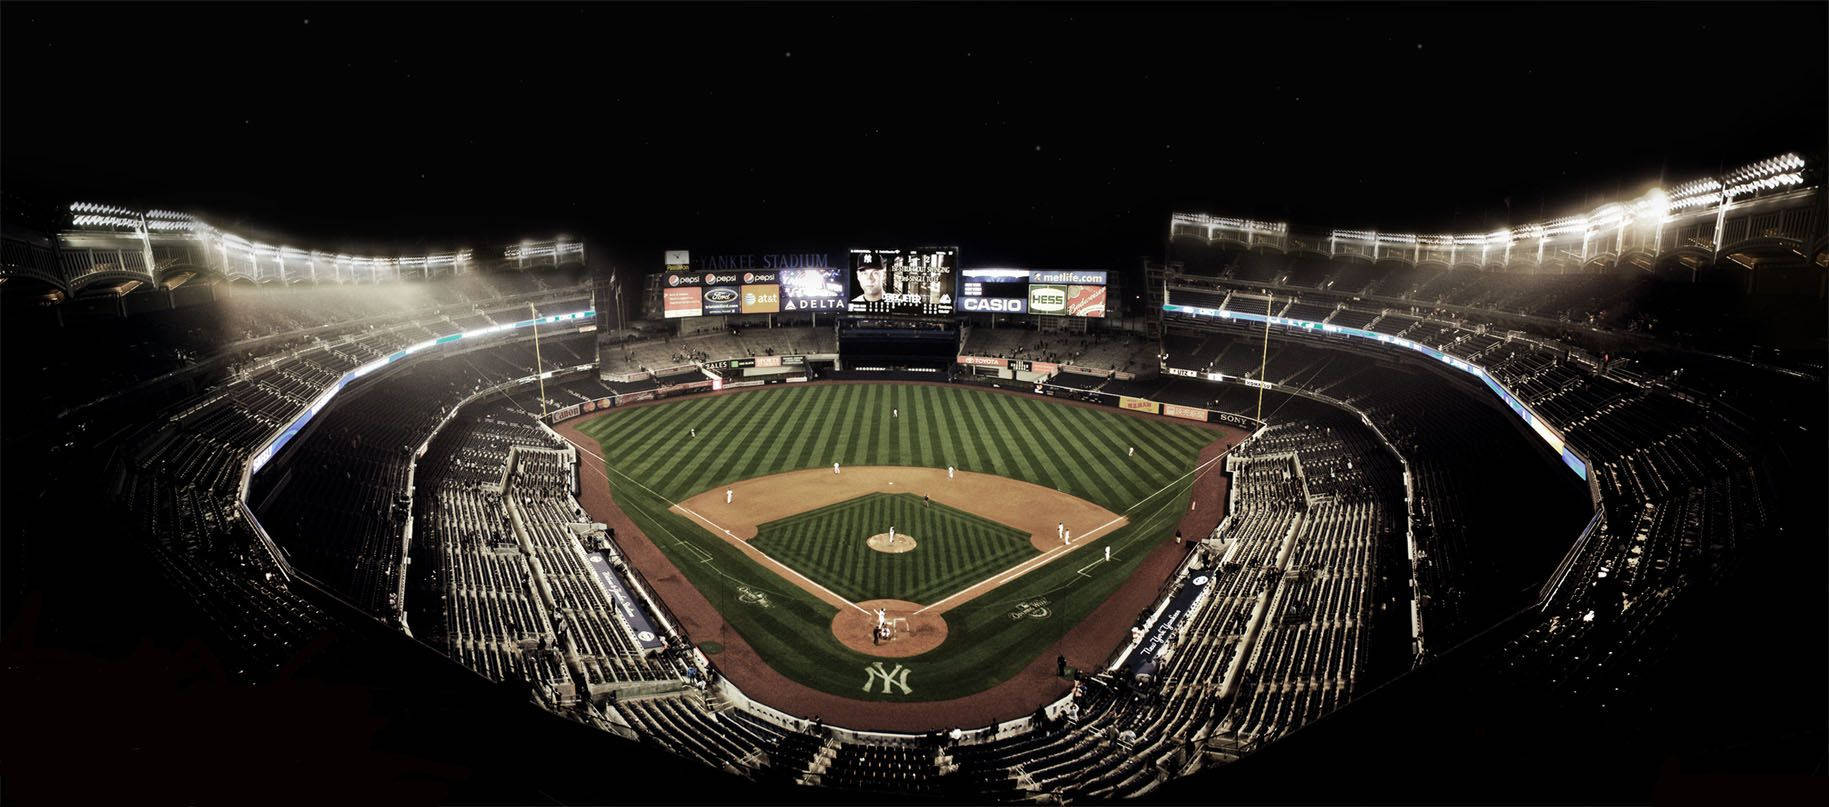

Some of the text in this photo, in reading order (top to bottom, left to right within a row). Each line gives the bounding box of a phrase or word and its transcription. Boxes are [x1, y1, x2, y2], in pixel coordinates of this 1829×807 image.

[700, 254, 754, 269] YANKEE
[764, 253, 829, 269] STADIUM
[680, 276, 700, 285] pepsi
[716, 274, 737, 283] pepsi
[754, 273, 775, 282] pepsi
[1043, 272, 1103, 283] metlife.com
[712, 291, 731, 301] Ford
[758, 293, 777, 303] at&t
[1033, 295, 1063, 305] HESS
[800, 299, 845, 309] DELTA
[964, 298, 1022, 312] CASIO
[975, 357, 999, 365] TOYOTA
[553, 407, 579, 421] Canon
[1220, 413, 1247, 425] SONY
[862, 661, 913, 695] NY
